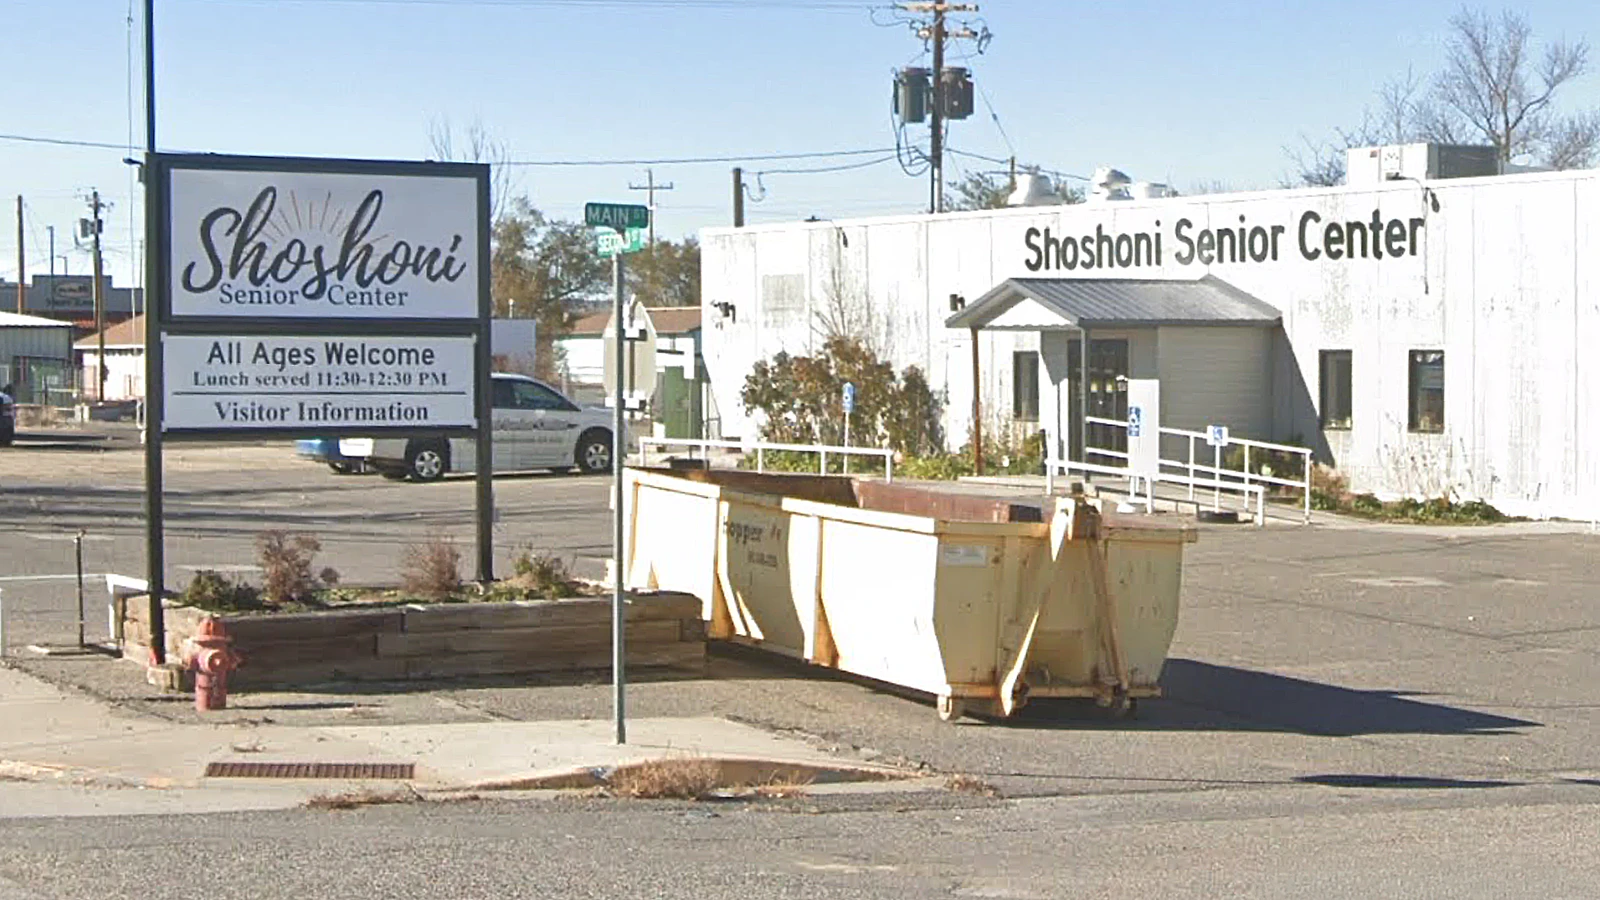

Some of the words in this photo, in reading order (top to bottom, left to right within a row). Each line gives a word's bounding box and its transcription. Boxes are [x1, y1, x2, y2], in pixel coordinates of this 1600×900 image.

[587, 205, 629, 225] MAIN
[182, 186, 466, 300] Shoshoni
[1024, 220, 1162, 271] Shoshoni
[1174, 214, 1285, 265] Senior
[1299, 209, 1425, 261] Center
[219, 283, 299, 305] Senior
[327, 284, 409, 306] Center
[207, 342, 242, 365] All
[252, 342, 316, 372] Ages
[324, 342, 435, 366] Welcome
[193, 371, 249, 387] Lunch
[255, 371, 310, 387] served
[316, 372, 413, 387] 11:30-12:30
[418, 372, 448, 387] PM
[214, 401, 291, 422] Visitor
[298, 402, 429, 422] Information
